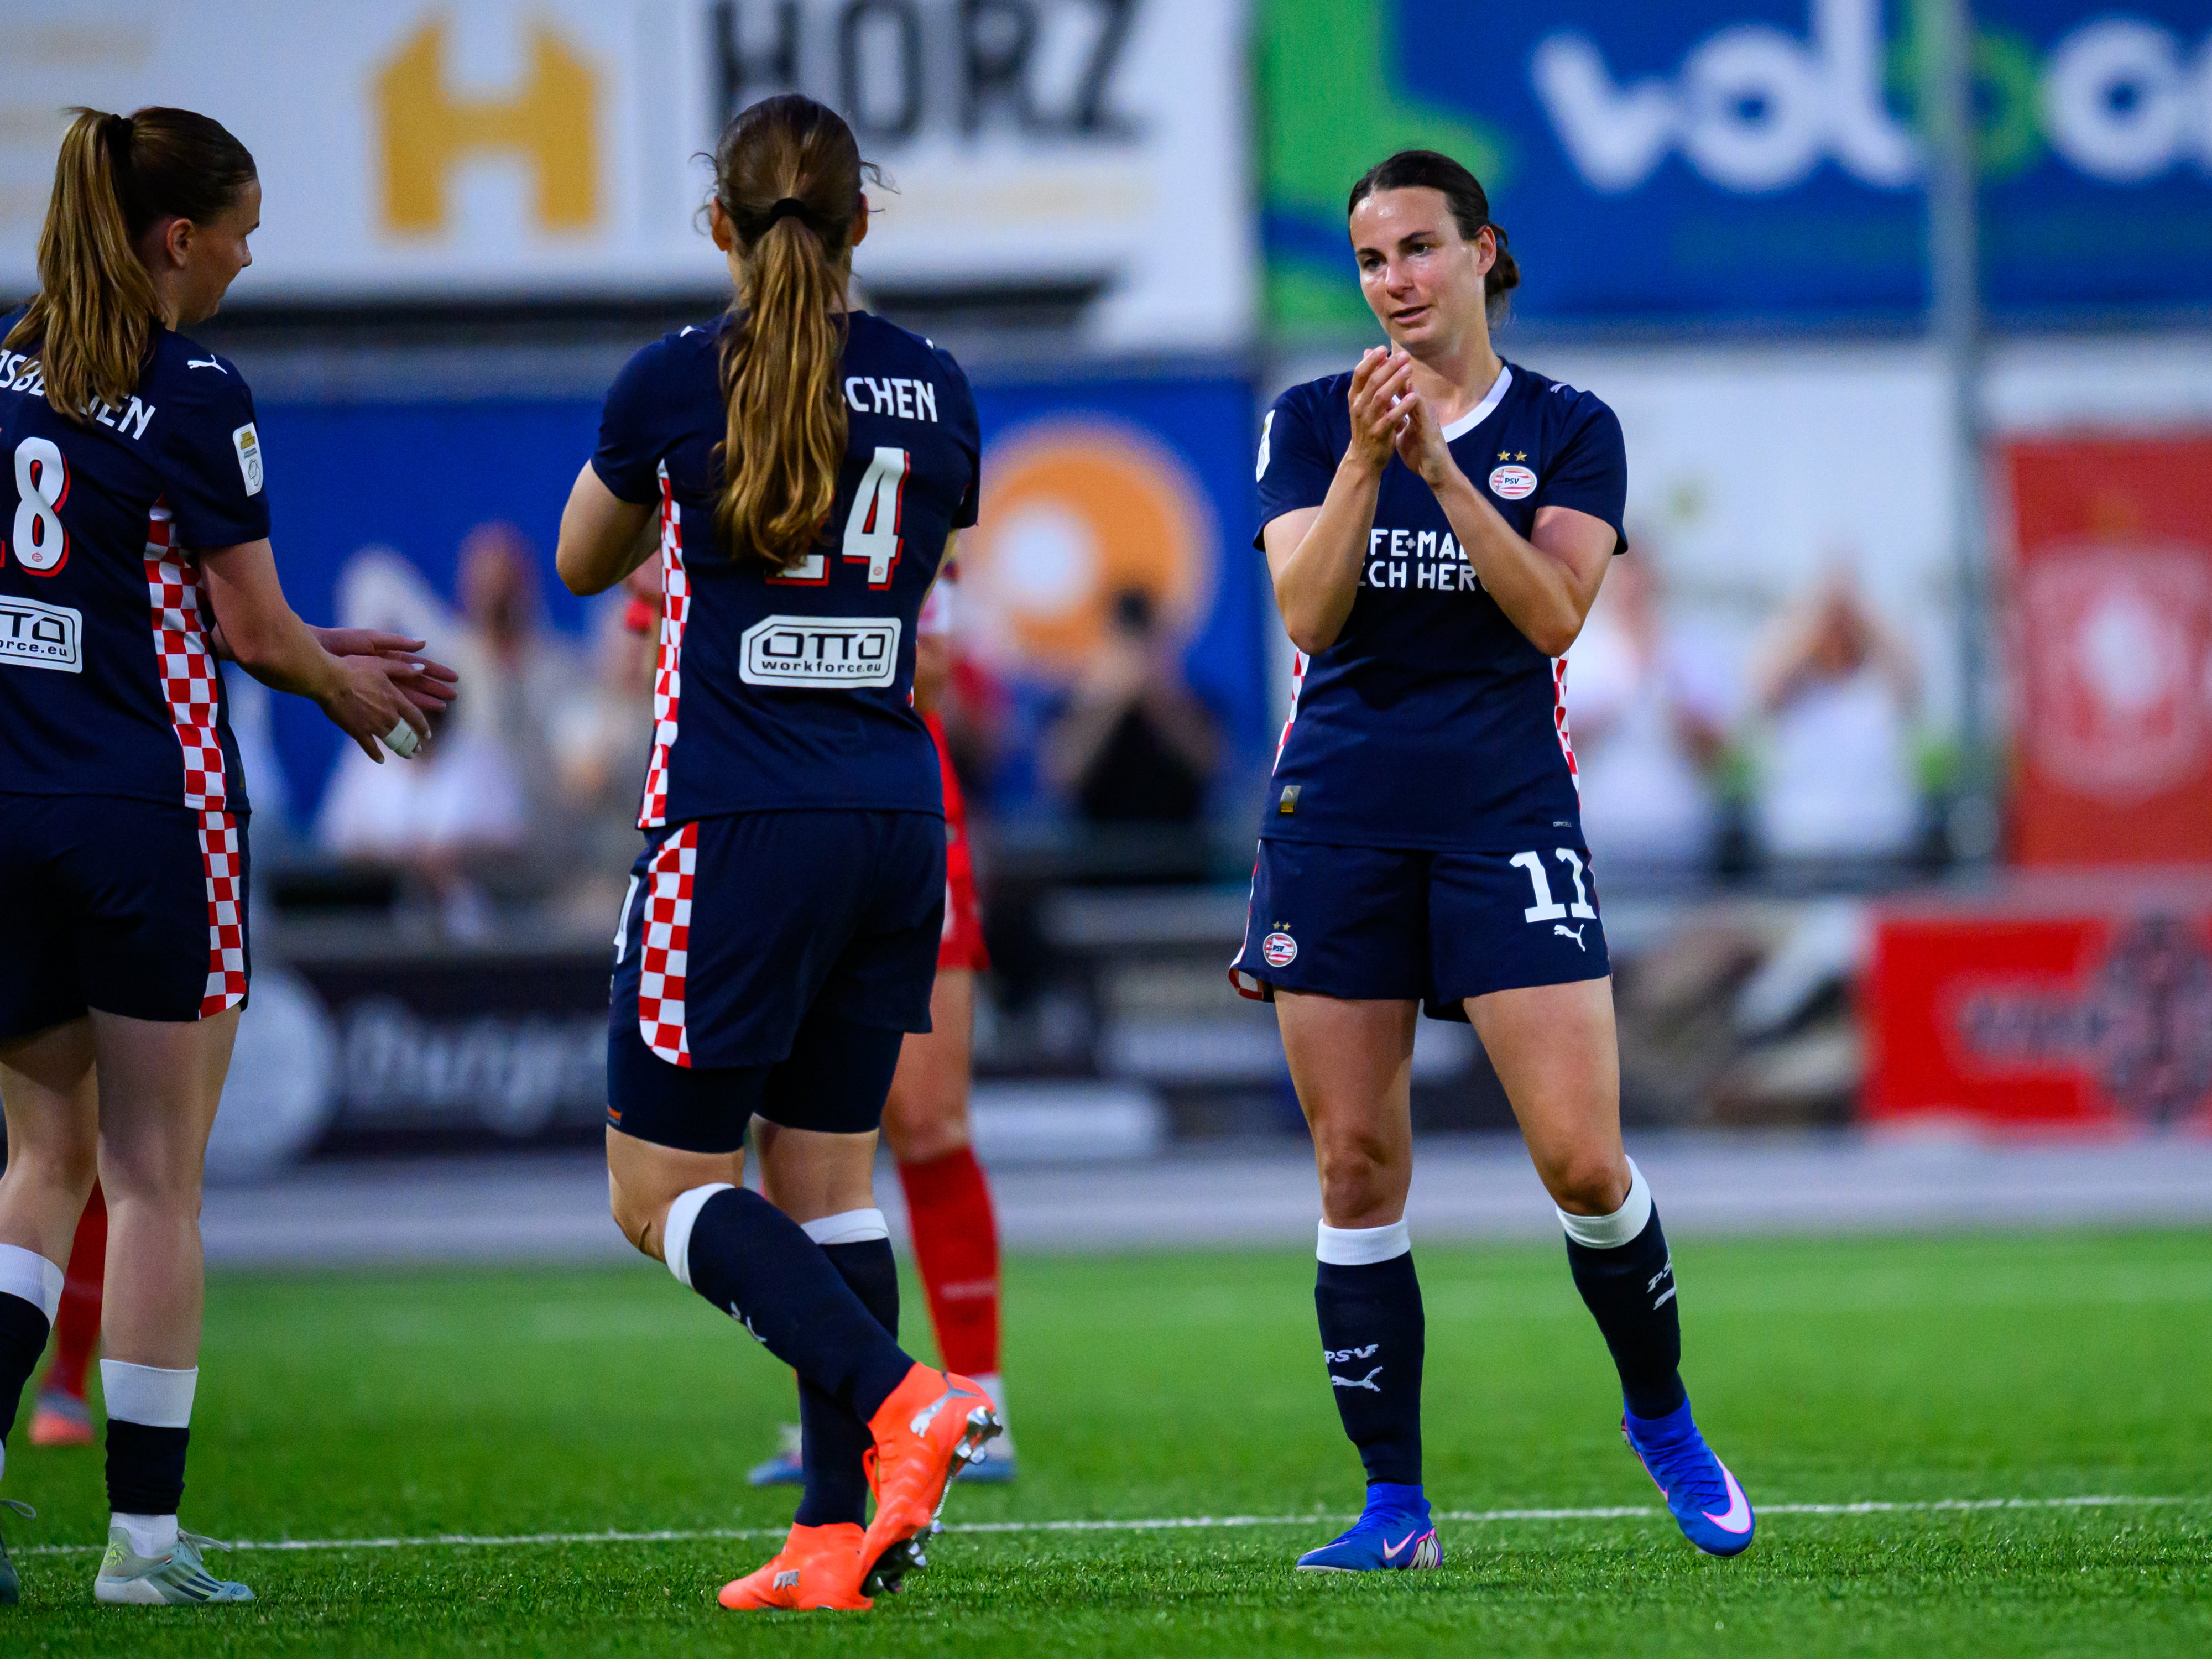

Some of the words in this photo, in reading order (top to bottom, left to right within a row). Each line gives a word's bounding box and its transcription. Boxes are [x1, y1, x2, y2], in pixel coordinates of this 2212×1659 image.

[841, 377, 938, 423] CHEN
[0, 429, 71, 577] 8
[1358, 560, 1407, 588] CH
[1417, 562, 1482, 592] HER
[0, 610, 66, 645] TO
[762, 632, 886, 660] OTTO
[761, 660, 881, 673] workforce.eu
[1509, 847, 1597, 923] 11
[1324, 1343, 1379, 1365] PSV
